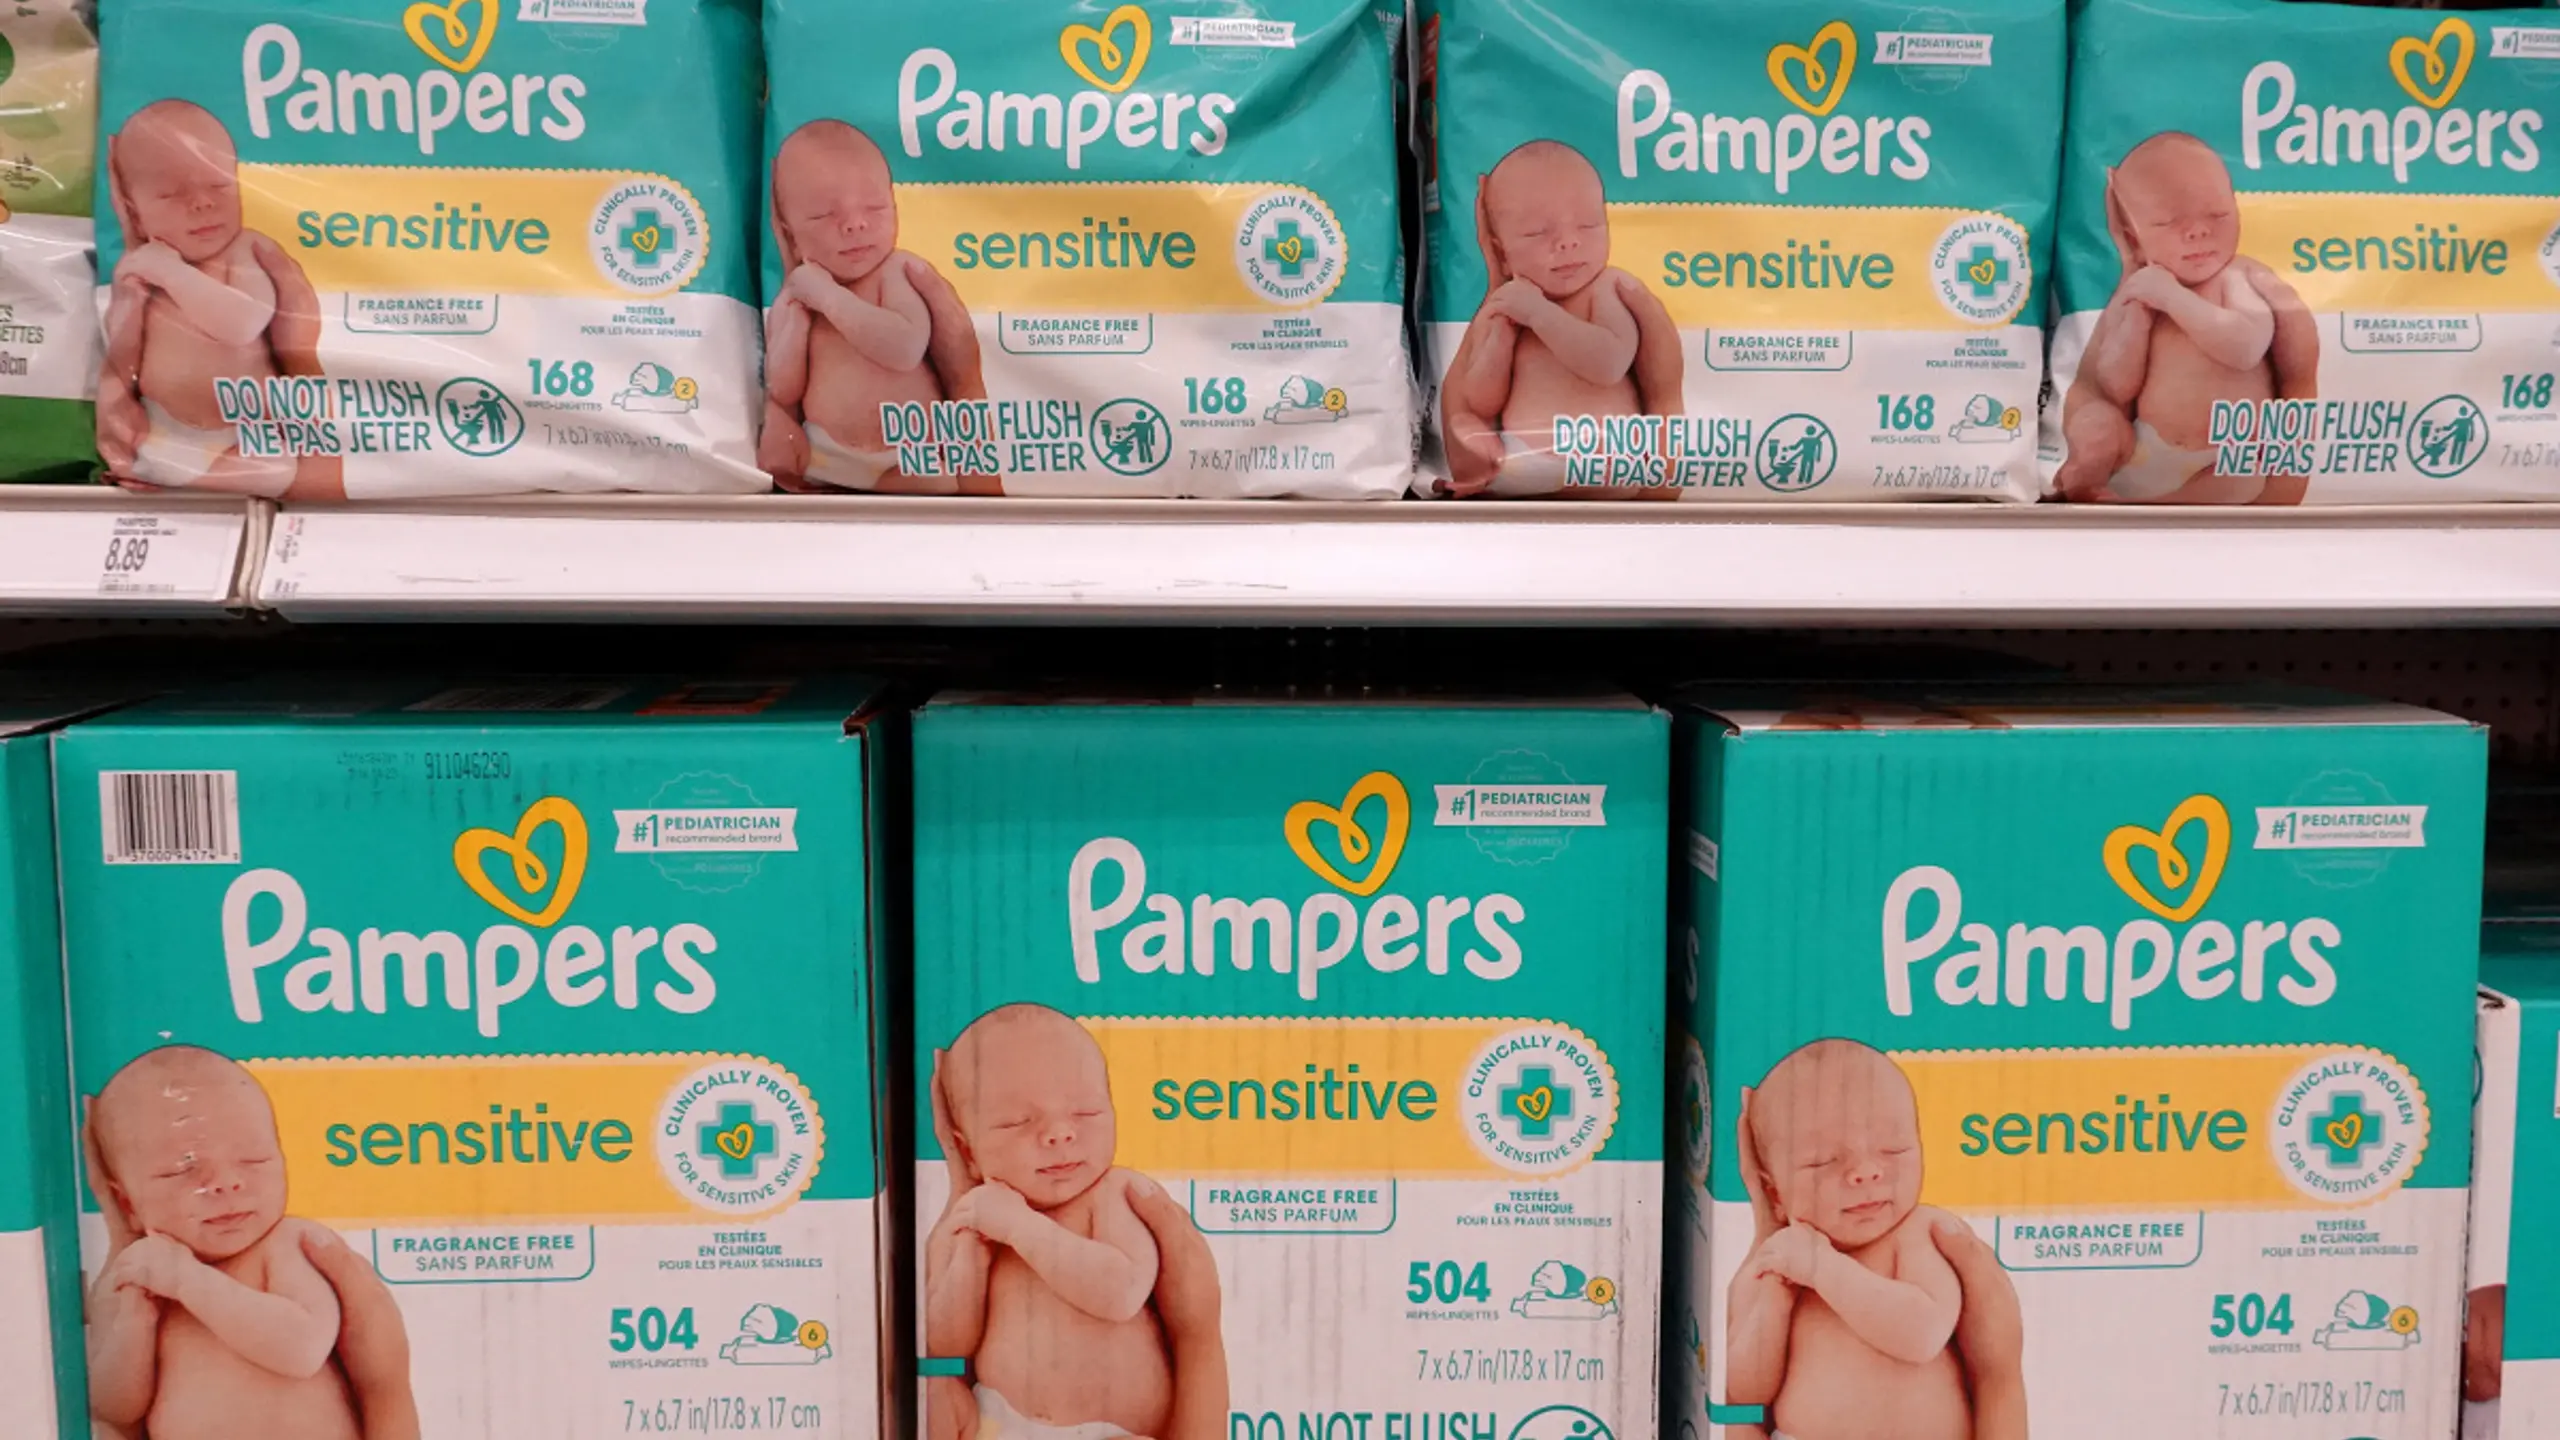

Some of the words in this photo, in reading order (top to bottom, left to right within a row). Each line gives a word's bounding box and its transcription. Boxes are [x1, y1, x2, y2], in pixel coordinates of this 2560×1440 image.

[1182, 21, 1201, 42] #1
[1886, 36, 1904, 60] #1
[1907, 37, 1984, 50] PEDIATRICIAN
[242, 23, 587, 155] Pampers
[898, 47, 1237, 170] Pampers
[2242, 60, 2543, 184] Pampers
[1617, 69, 1932, 195] Pampers
[297, 202, 550, 255] sensitive
[953, 217, 1197, 270] sensitive
[1663, 240, 1894, 290] sensitive
[2293, 223, 2509, 275] sensitive
[358, 299, 444, 312] FRAGRANCE
[448, 299, 484, 312] FREE
[373, 313, 409, 325] SANS
[413, 313, 469, 325] PARFUM
[0, 325, 44, 344] ETTES
[1011, 319, 1100, 333] FRAGRANCE
[1104, 319, 1139, 333] FREE
[1028, 333, 1063, 346] SANS
[1068, 333, 1125, 346] PARFUM
[2354, 319, 2436, 330] FRAGRANCE
[2439, 319, 2469, 330] FREE
[2368, 332, 2404, 344] SANS
[2407, 332, 2457, 343] PARFUM
[1719, 336, 1803, 349] FRAGRANCE
[1807, 336, 1839, 348] FREE
[1733, 349, 1770, 362] SANS
[1773, 349, 1826, 363] PARFUM
[528, 358, 594, 397] 168
[2502, 373, 2554, 409] 168
[217, 380, 262, 419] DO
[270, 379, 332, 419] NOT
[340, 380, 429, 418] FLUSH
[1184, 377, 1247, 414] 168
[1332, 394, 1339, 405] 2
[882, 404, 927, 442] DO
[935, 402, 993, 440] NOT
[1000, 401, 1084, 438] FLUSH
[1877, 394, 1935, 431] 168
[2211, 403, 2254, 441] DO
[2261, 402, 2316, 441] NOT
[2322, 402, 2407, 440] FLUSH
[241, 425, 281, 455] NE
[289, 422, 342, 454] PAS
[350, 421, 432, 453] JETER
[1555, 418, 1596, 454] DO
[1606, 417, 1663, 455] NOT
[1668, 418, 1751, 459] FLUSH
[901, 447, 940, 475] NE
[948, 444, 999, 474] PAS
[1008, 442, 1087, 472] JETER
[1566, 459, 1605, 486] NE
[1611, 459, 1666, 487] PAS
[1669, 461, 1749, 488] JETER
[2217, 446, 2257, 474] NE
[2261, 445, 2315, 473] PAS
[2320, 444, 2399, 473] JETER
[105, 537, 149, 572] 8.89
[1451, 789, 1476, 821] #1
[1481, 793, 1591, 805] PEDIATRICIAN
[1481, 808, 1557, 818] recommended
[1560, 807, 1591, 818] brand
[632, 814, 658, 847] #1
[664, 816, 781, 830] PEDIATRICIAN
[665, 833, 746, 844] recommended
[749, 832, 782, 843] brand
[2271, 812, 2297, 844] #1
[2302, 814, 2411, 826] PEDIATRICIAN
[1068, 836, 1526, 1001] Pampers
[221, 867, 717, 1038] Pampers
[1882, 865, 2342, 1031] Pampers
[1468, 1035, 1552, 1098] CLINICALLY
[1556, 1040, 1604, 1098] PROVEN
[665, 1070, 752, 1136] CLINICALLY
[756, 1074, 809, 1135] PROVEN
[1152, 1064, 1437, 1121] sensitive
[2278, 1061, 2365, 1127] CLINICALLY
[2367, 1065, 2414, 1125] PROVEN
[325, 1103, 633, 1167] sensitive
[1476, 1112, 1497, 1142] FOR
[1495, 1141, 1570, 1164] SENSITIVE
[1570, 1115, 1598, 1148] SKIN
[1960, 1094, 2248, 1156] sensitive
[674, 1151, 698, 1184] FOR
[697, 1180, 776, 1204] SENSITIVE
[775, 1152, 803, 1186] SKIN
[2285, 1141, 2306, 1173] FOR
[2303, 1170, 2379, 1193] SENSITIVE
[2379, 1142, 2407, 1176] SKIN
[1209, 1189, 1328, 1204] FRAGRANCE
[1333, 1190, 1379, 1204] FREE
[1495, 1203, 1511, 1213] EN
[1514, 1203, 1574, 1214] CLINIQUE
[1509, 1189, 1560, 1201] TESTÉES
[1230, 1208, 1278, 1222] SANS
[1284, 1208, 1359, 1223] PARFUM
[1457, 1216, 1488, 1226] POUR
[1491, 1217, 1511, 1226] LES
[1514, 1217, 1550, 1226] PEAUX
[2014, 1223, 2134, 1240] FRAGRANCE
[2139, 1222, 2185, 1238] FREE
[392, 1236, 521, 1253] FRAGRANCE
[527, 1234, 575, 1250] FREE
[698, 1246, 716, 1257] EN
[719, 1245, 782, 1256] CLINIQUE
[713, 1230, 767, 1243] TESTÉES
[2034, 1242, 2083, 1259] SANS
[2088, 1241, 2163, 1257] PARFUM
[416, 1255, 468, 1272] SANS
[474, 1254, 555, 1270] PARFUM
[659, 1260, 692, 1270] POUR
[695, 1260, 716, 1270] LES
[719, 1259, 758, 1269] PEAUX
[762, 1258, 823, 1269] SENSIBLES
[1406, 1260, 1491, 1304] 504
[1595, 1284, 1605, 1298] 6
[609, 1306, 699, 1352] 504
[2210, 1293, 2295, 1338] 504
[2399, 1314, 2409, 1327] 6
[808, 1329, 818, 1342] 6
[1417, 1350, 1428, 1381] 7
[1433, 1358, 1443, 1380] x
[1446, 1350, 1473, 1381] 6.7
[1478, 1348, 1533, 1385] in/17.8
[1538, 1358, 1547, 1380] x
[1554, 1350, 1572, 1380] 17
[1576, 1358, 1604, 1381] cm
[624, 1400, 634, 1432] 7
[639, 1408, 650, 1430] x
[654, 1399, 682, 1431] 6.7
[688, 1397, 746, 1435] in/17.8
[750, 1405, 761, 1429] x
[768, 1397, 786, 1429] 17
[791, 1404, 820, 1429] cm
